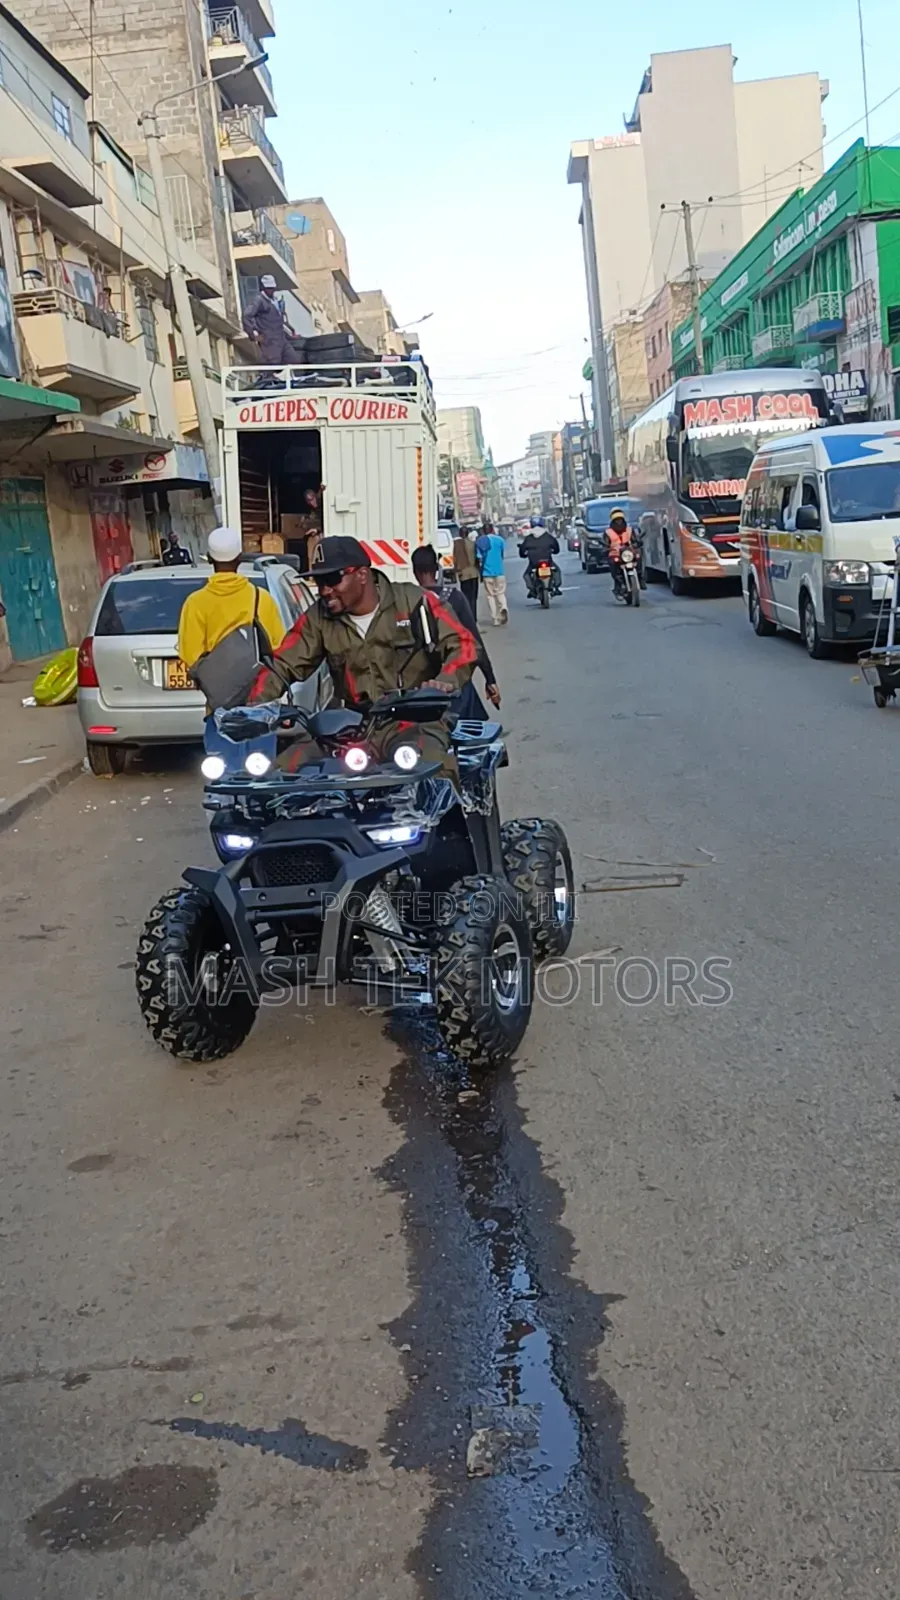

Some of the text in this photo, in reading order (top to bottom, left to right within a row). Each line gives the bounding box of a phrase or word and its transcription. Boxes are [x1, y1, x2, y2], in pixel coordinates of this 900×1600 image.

[239, 397, 408, 423] OLTEPES COURIER
[684, 396, 753, 428] MASH
[757, 393, 820, 420] COOL
